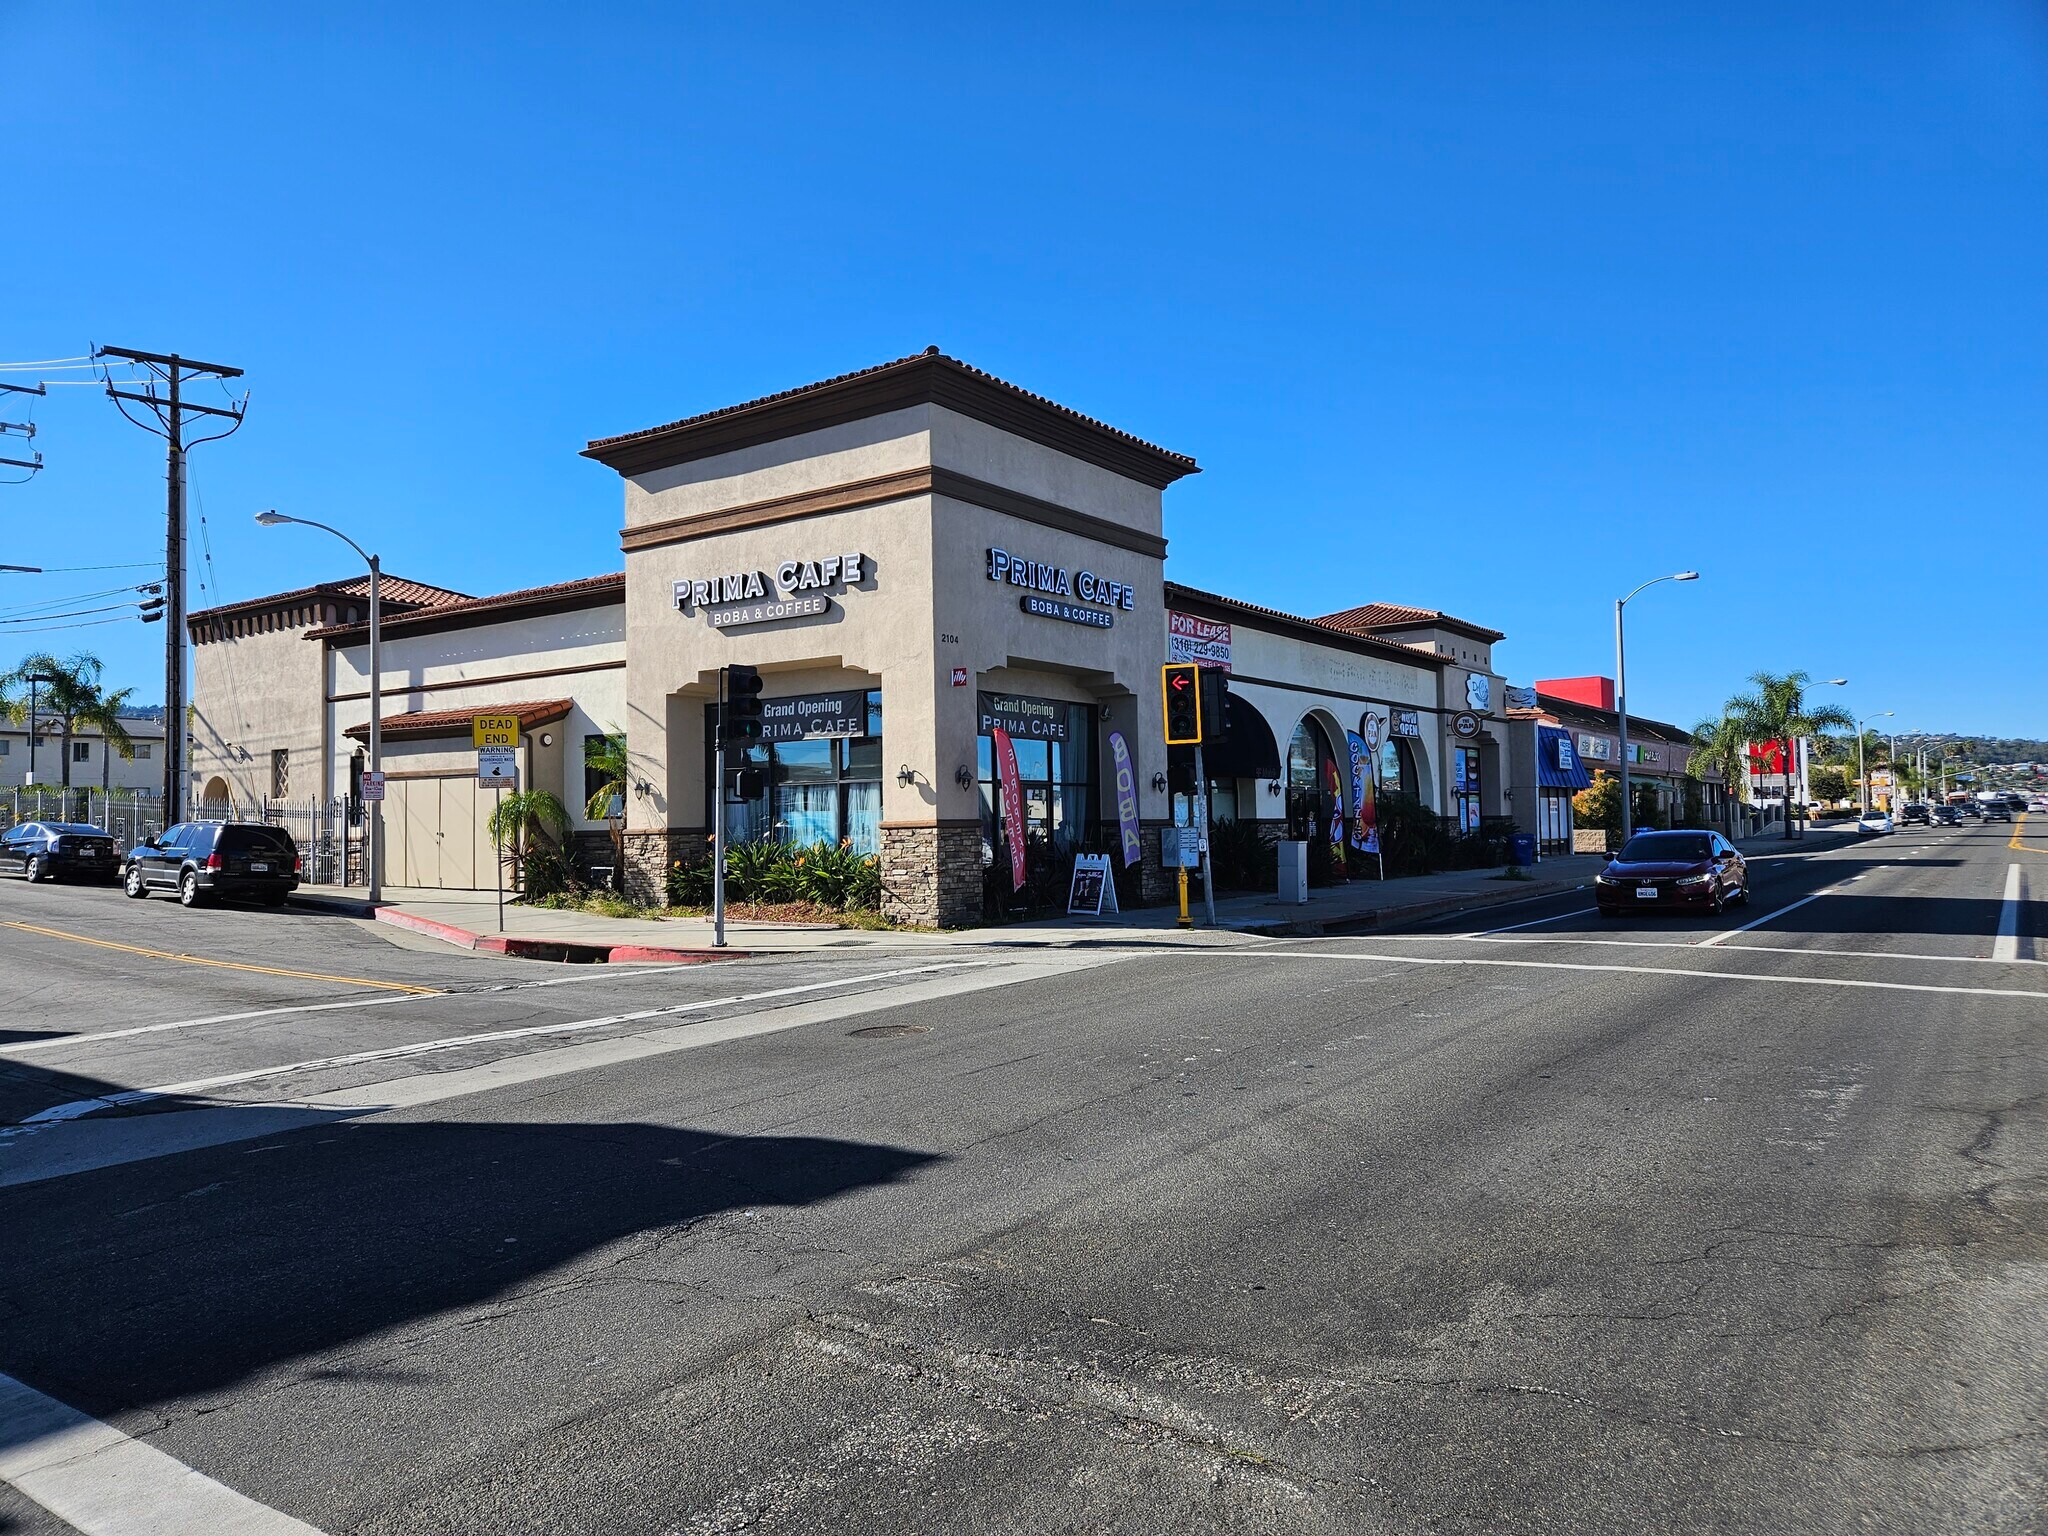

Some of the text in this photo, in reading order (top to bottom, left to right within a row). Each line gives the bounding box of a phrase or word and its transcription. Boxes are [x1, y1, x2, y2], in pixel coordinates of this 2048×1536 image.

[672, 553, 861, 610] PRIMA CAFE
[992, 548, 1133, 610] PRIMA CAFE
[714, 599, 821, 625] BOBA & COFFEE
[1031, 599, 1110, 626] BOBA & COFFEE
[1171, 614, 1229, 642] FOR LEASE
[941, 634, 959, 644] 2104
[1171, 636, 1191, 653] (310)
[1194, 641, 1229, 659] 229-9850
[764, 699, 842, 717] Grand Opening
[994, 697, 1054, 719] Grand Opening
[1402, 711, 1417, 723] NOW
[480, 719, 513, 729] DEAD
[762, 718, 858, 738] RIMA CAFE
[1031, 720, 1064, 737] CAFE
[1400, 722, 1418, 736] OPEN
[485, 734, 509, 744] END
